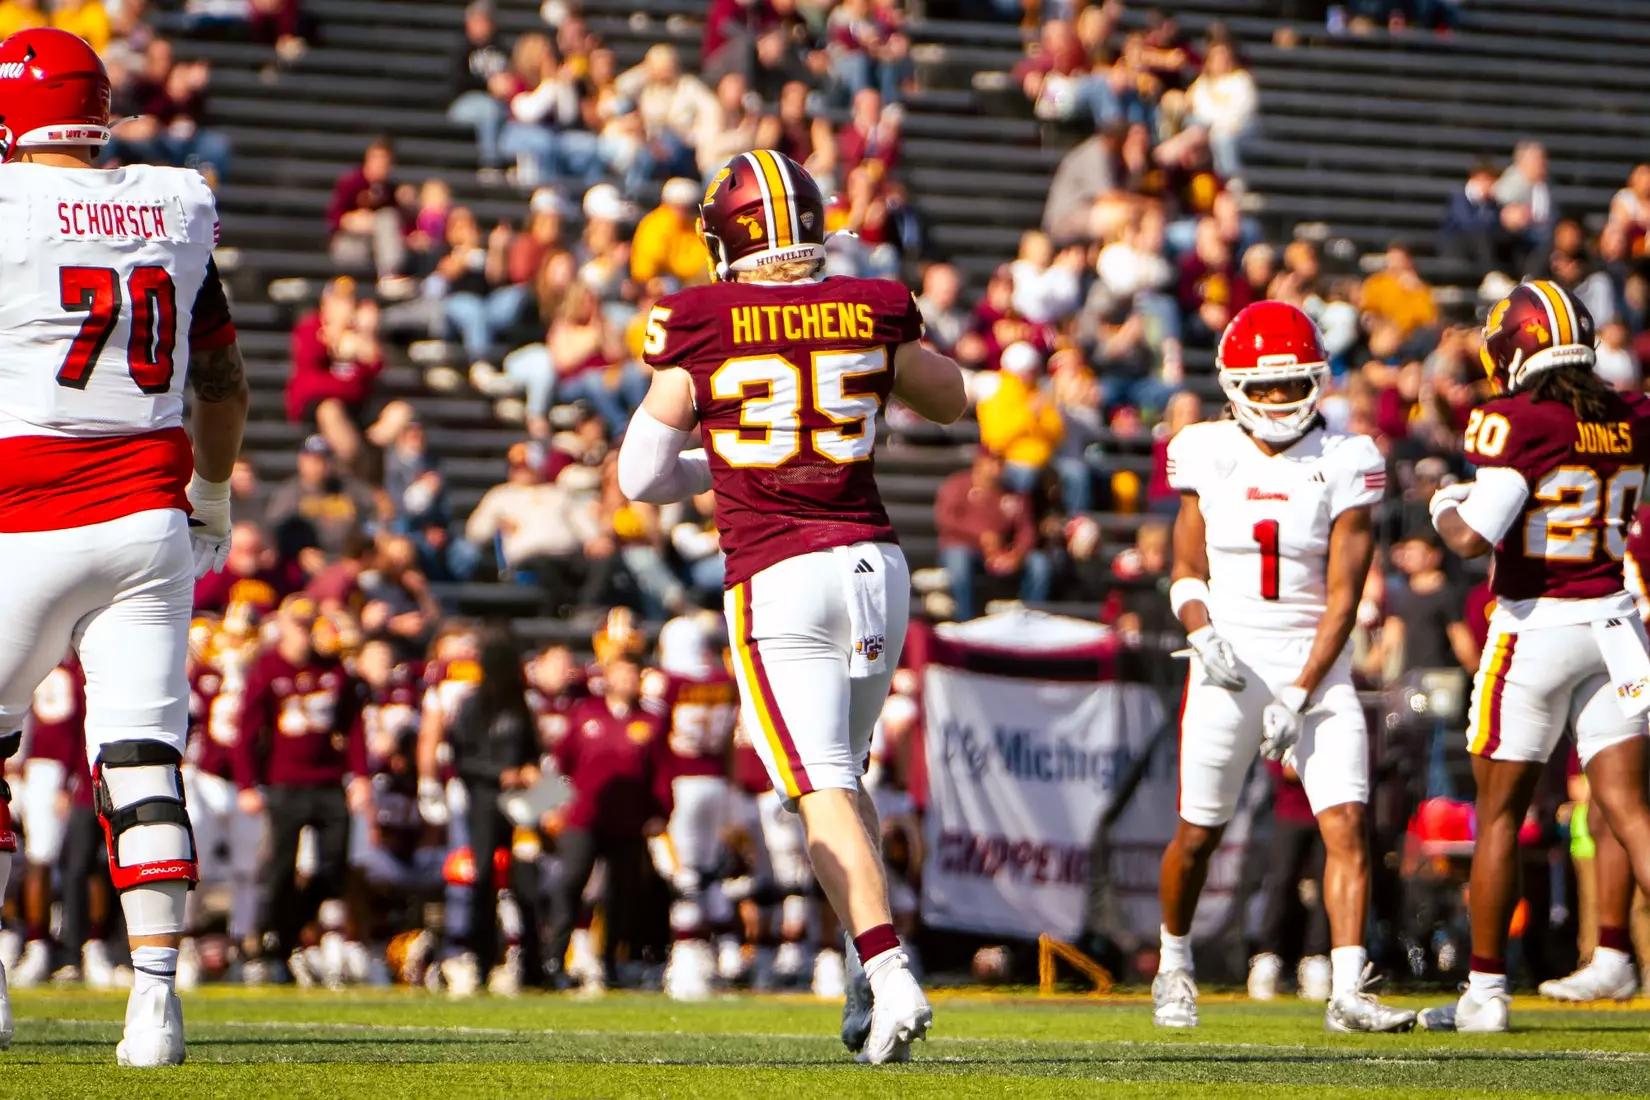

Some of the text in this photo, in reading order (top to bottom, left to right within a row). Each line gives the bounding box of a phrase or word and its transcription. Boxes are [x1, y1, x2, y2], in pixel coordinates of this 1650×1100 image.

[57, 202, 168, 239] SCHORSCH
[756, 247, 815, 267] HUMILITY
[56, 265, 177, 395] 70
[732, 303, 873, 343] HITCHENS
[708, 344, 888, 469] 35
[1464, 408, 1511, 457] 20
[1575, 420, 1633, 454] JONES
[1523, 464, 1645, 562] 20
[1252, 518, 1280, 601] 1
[140, 865, 184, 877] DONJOY
